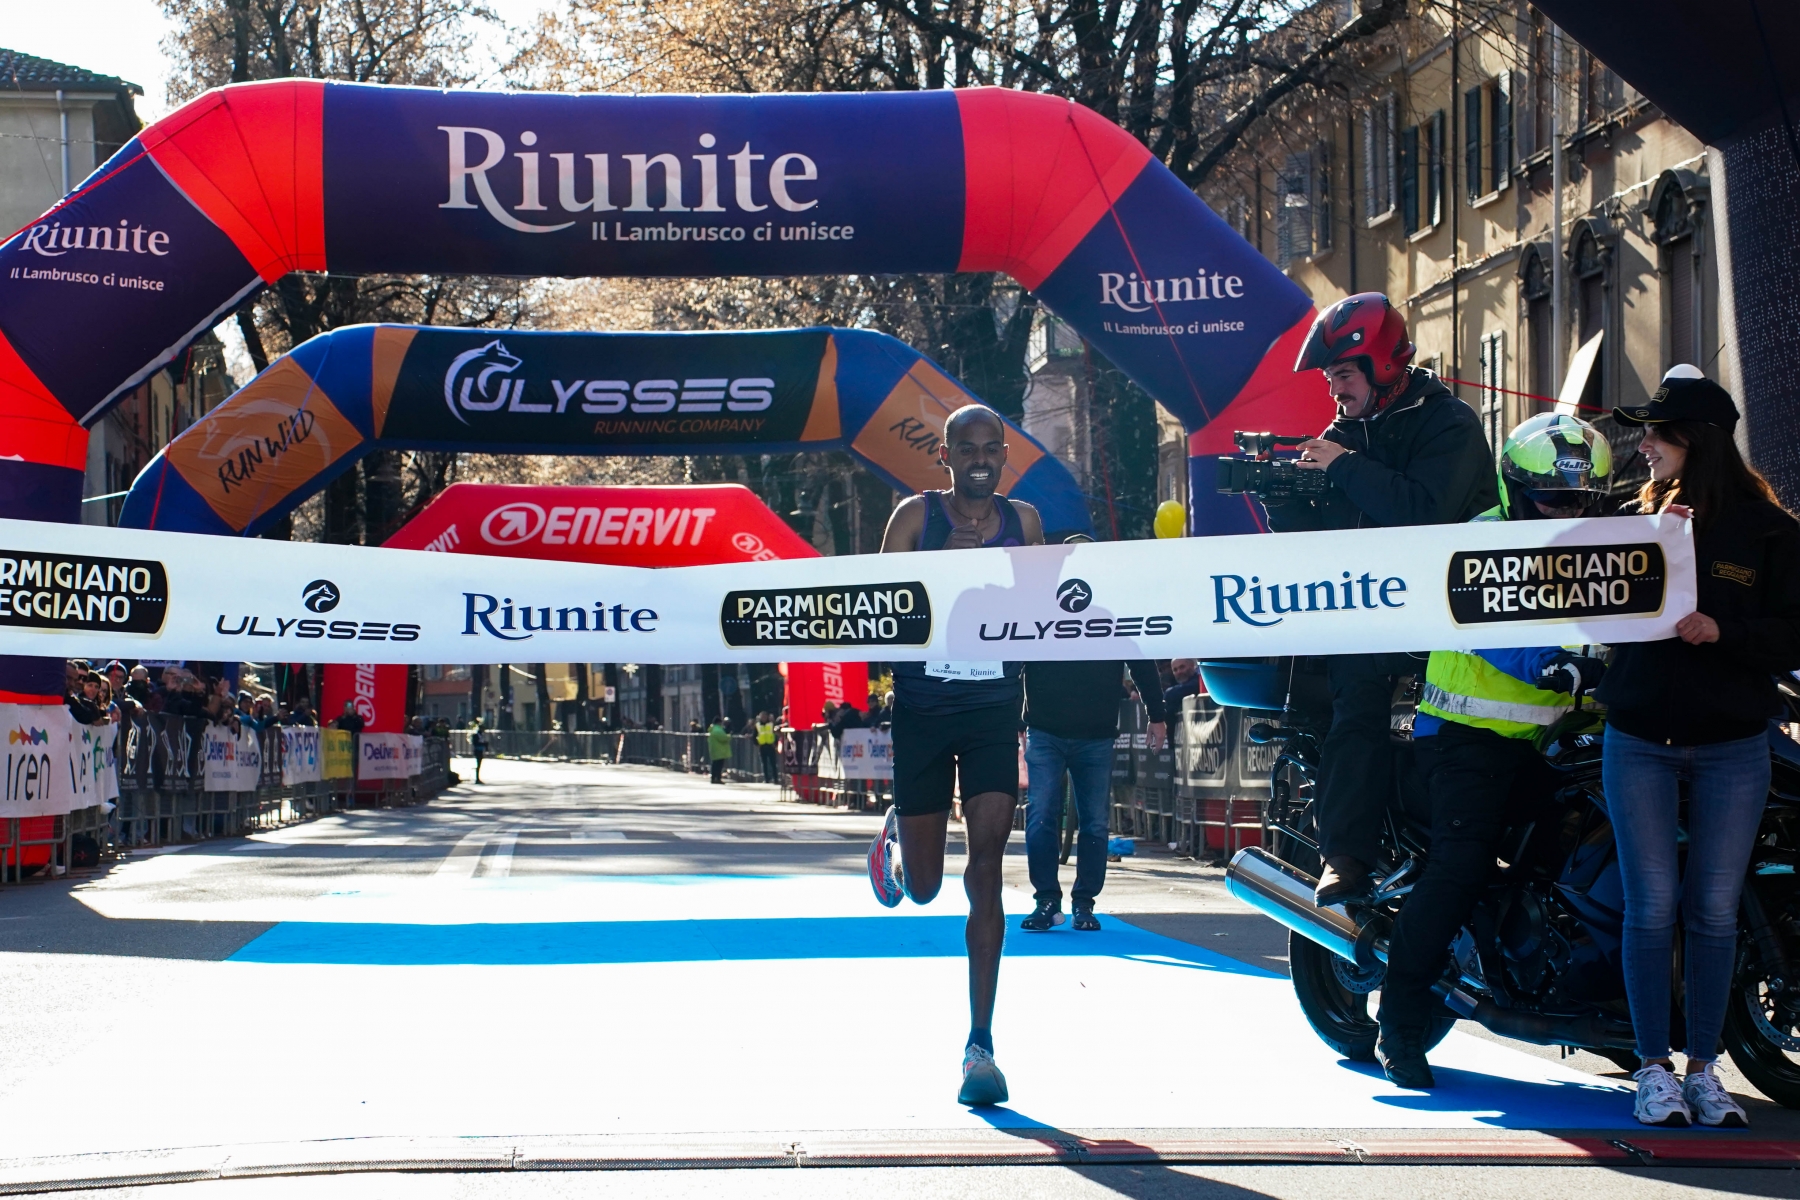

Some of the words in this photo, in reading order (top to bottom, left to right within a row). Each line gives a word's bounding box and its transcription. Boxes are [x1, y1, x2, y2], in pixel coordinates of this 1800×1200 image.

[437, 126, 818, 233] Riunite
[18, 219, 170, 256] Riunite
[592, 221, 607, 241] Il
[616, 221, 745, 241] Lambrusco
[753, 222, 771, 241] ci
[781, 222, 854, 241] unisce
[10, 268, 19, 279] Il
[23, 267, 99, 284] Lambrusco
[103, 273, 115, 286] ci
[119, 276, 164, 291] unisce
[1098, 268, 1244, 312] Riunite
[1103, 322, 1113, 332] Il
[1115, 322, 1184, 335] Lambrusco
[1188, 321, 1199, 334] ci
[1203, 320, 1244, 333] unisce
[459, 377, 775, 413] ULYSSES
[594, 420, 676, 435] RUNNING
[680, 418, 766, 434] COMPANY
[218, 440, 263, 494] RUN
[1559, 460, 1590, 470] HJC
[541, 506, 716, 547] ENERVIT
[1463, 550, 1648, 584] PARMIGIANO
[737, 588, 914, 619] PARMIGIANO
[1210, 570, 1408, 627] Riunite
[1483, 579, 1630, 613] REGGIANO
[215, 614, 421, 641] ULYSSES
[461, 592, 660, 640] Riunite
[755, 616, 898, 639] REGGIANO
[979, 615, 1173, 641] ULYSSES
[970, 668, 996, 677] Riunite
